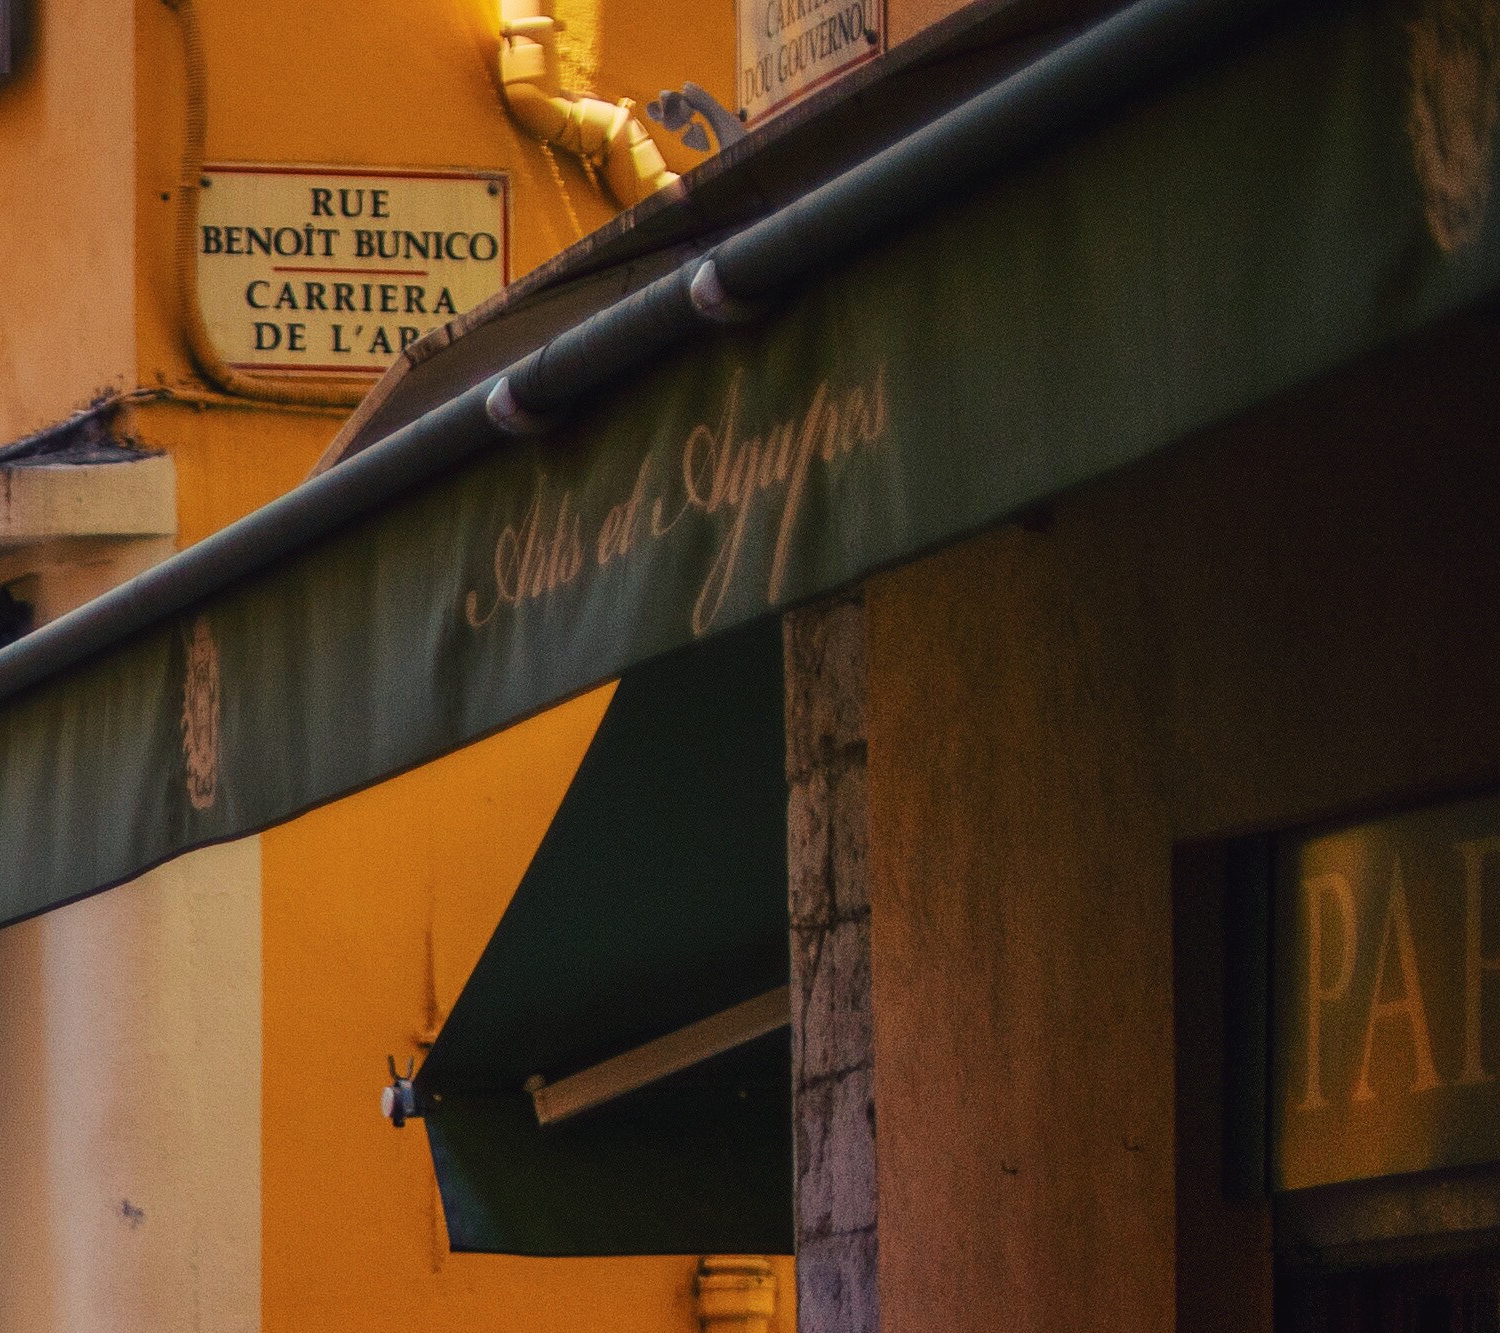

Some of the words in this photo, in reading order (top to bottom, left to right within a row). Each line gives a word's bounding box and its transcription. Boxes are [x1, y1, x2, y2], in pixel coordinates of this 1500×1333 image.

[311, 186, 390, 218] RUE
[201, 222, 340, 257] BENOÎT
[354, 228, 499, 261] BUNICO
[246, 279, 458, 315] CARRIERA
[254, 321, 306, 352] DE
